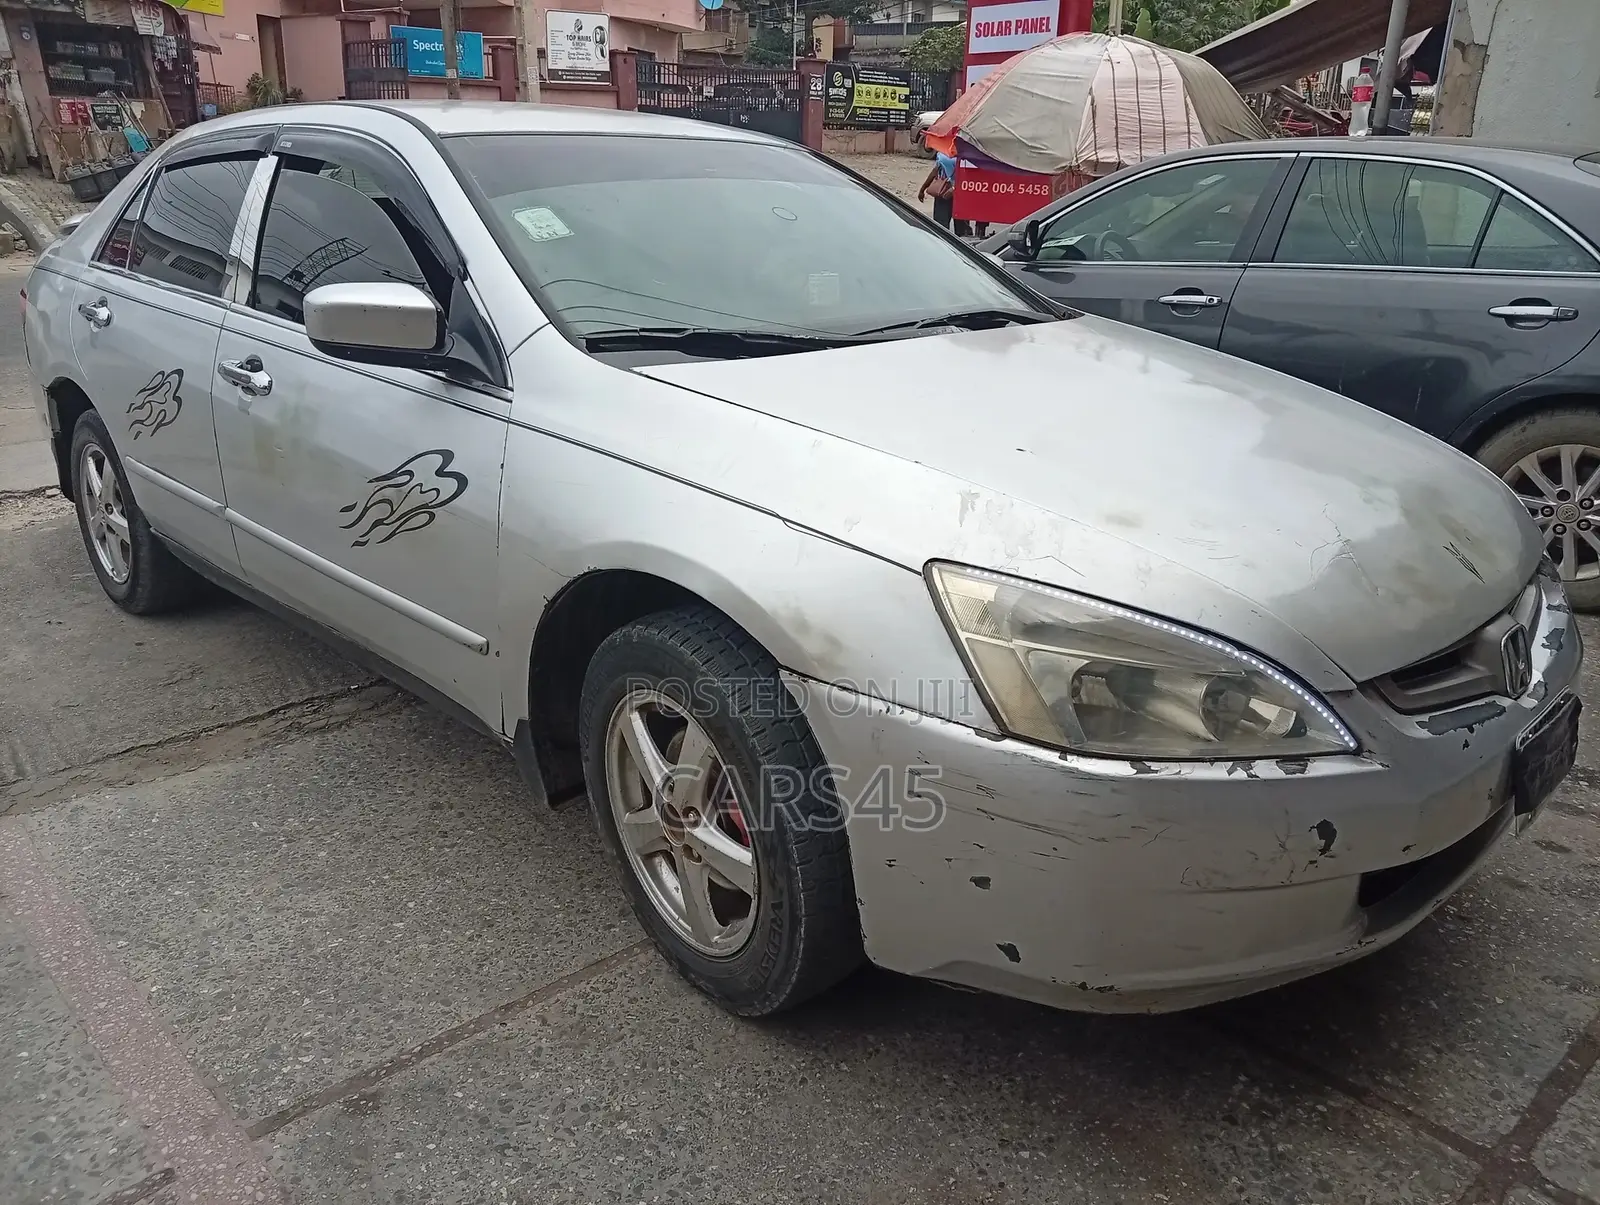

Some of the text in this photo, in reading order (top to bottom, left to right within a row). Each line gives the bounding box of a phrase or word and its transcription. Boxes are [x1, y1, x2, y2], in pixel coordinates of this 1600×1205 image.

[975, 16, 1051, 38] SOLAR PANEL
[413, 39, 464, 53] Spectrt
[810, 77, 823, 91] 28
[961, 180, 989, 194] 0902
[992, 181, 1015, 195] 004
[1018, 182, 1050, 196] 5458
